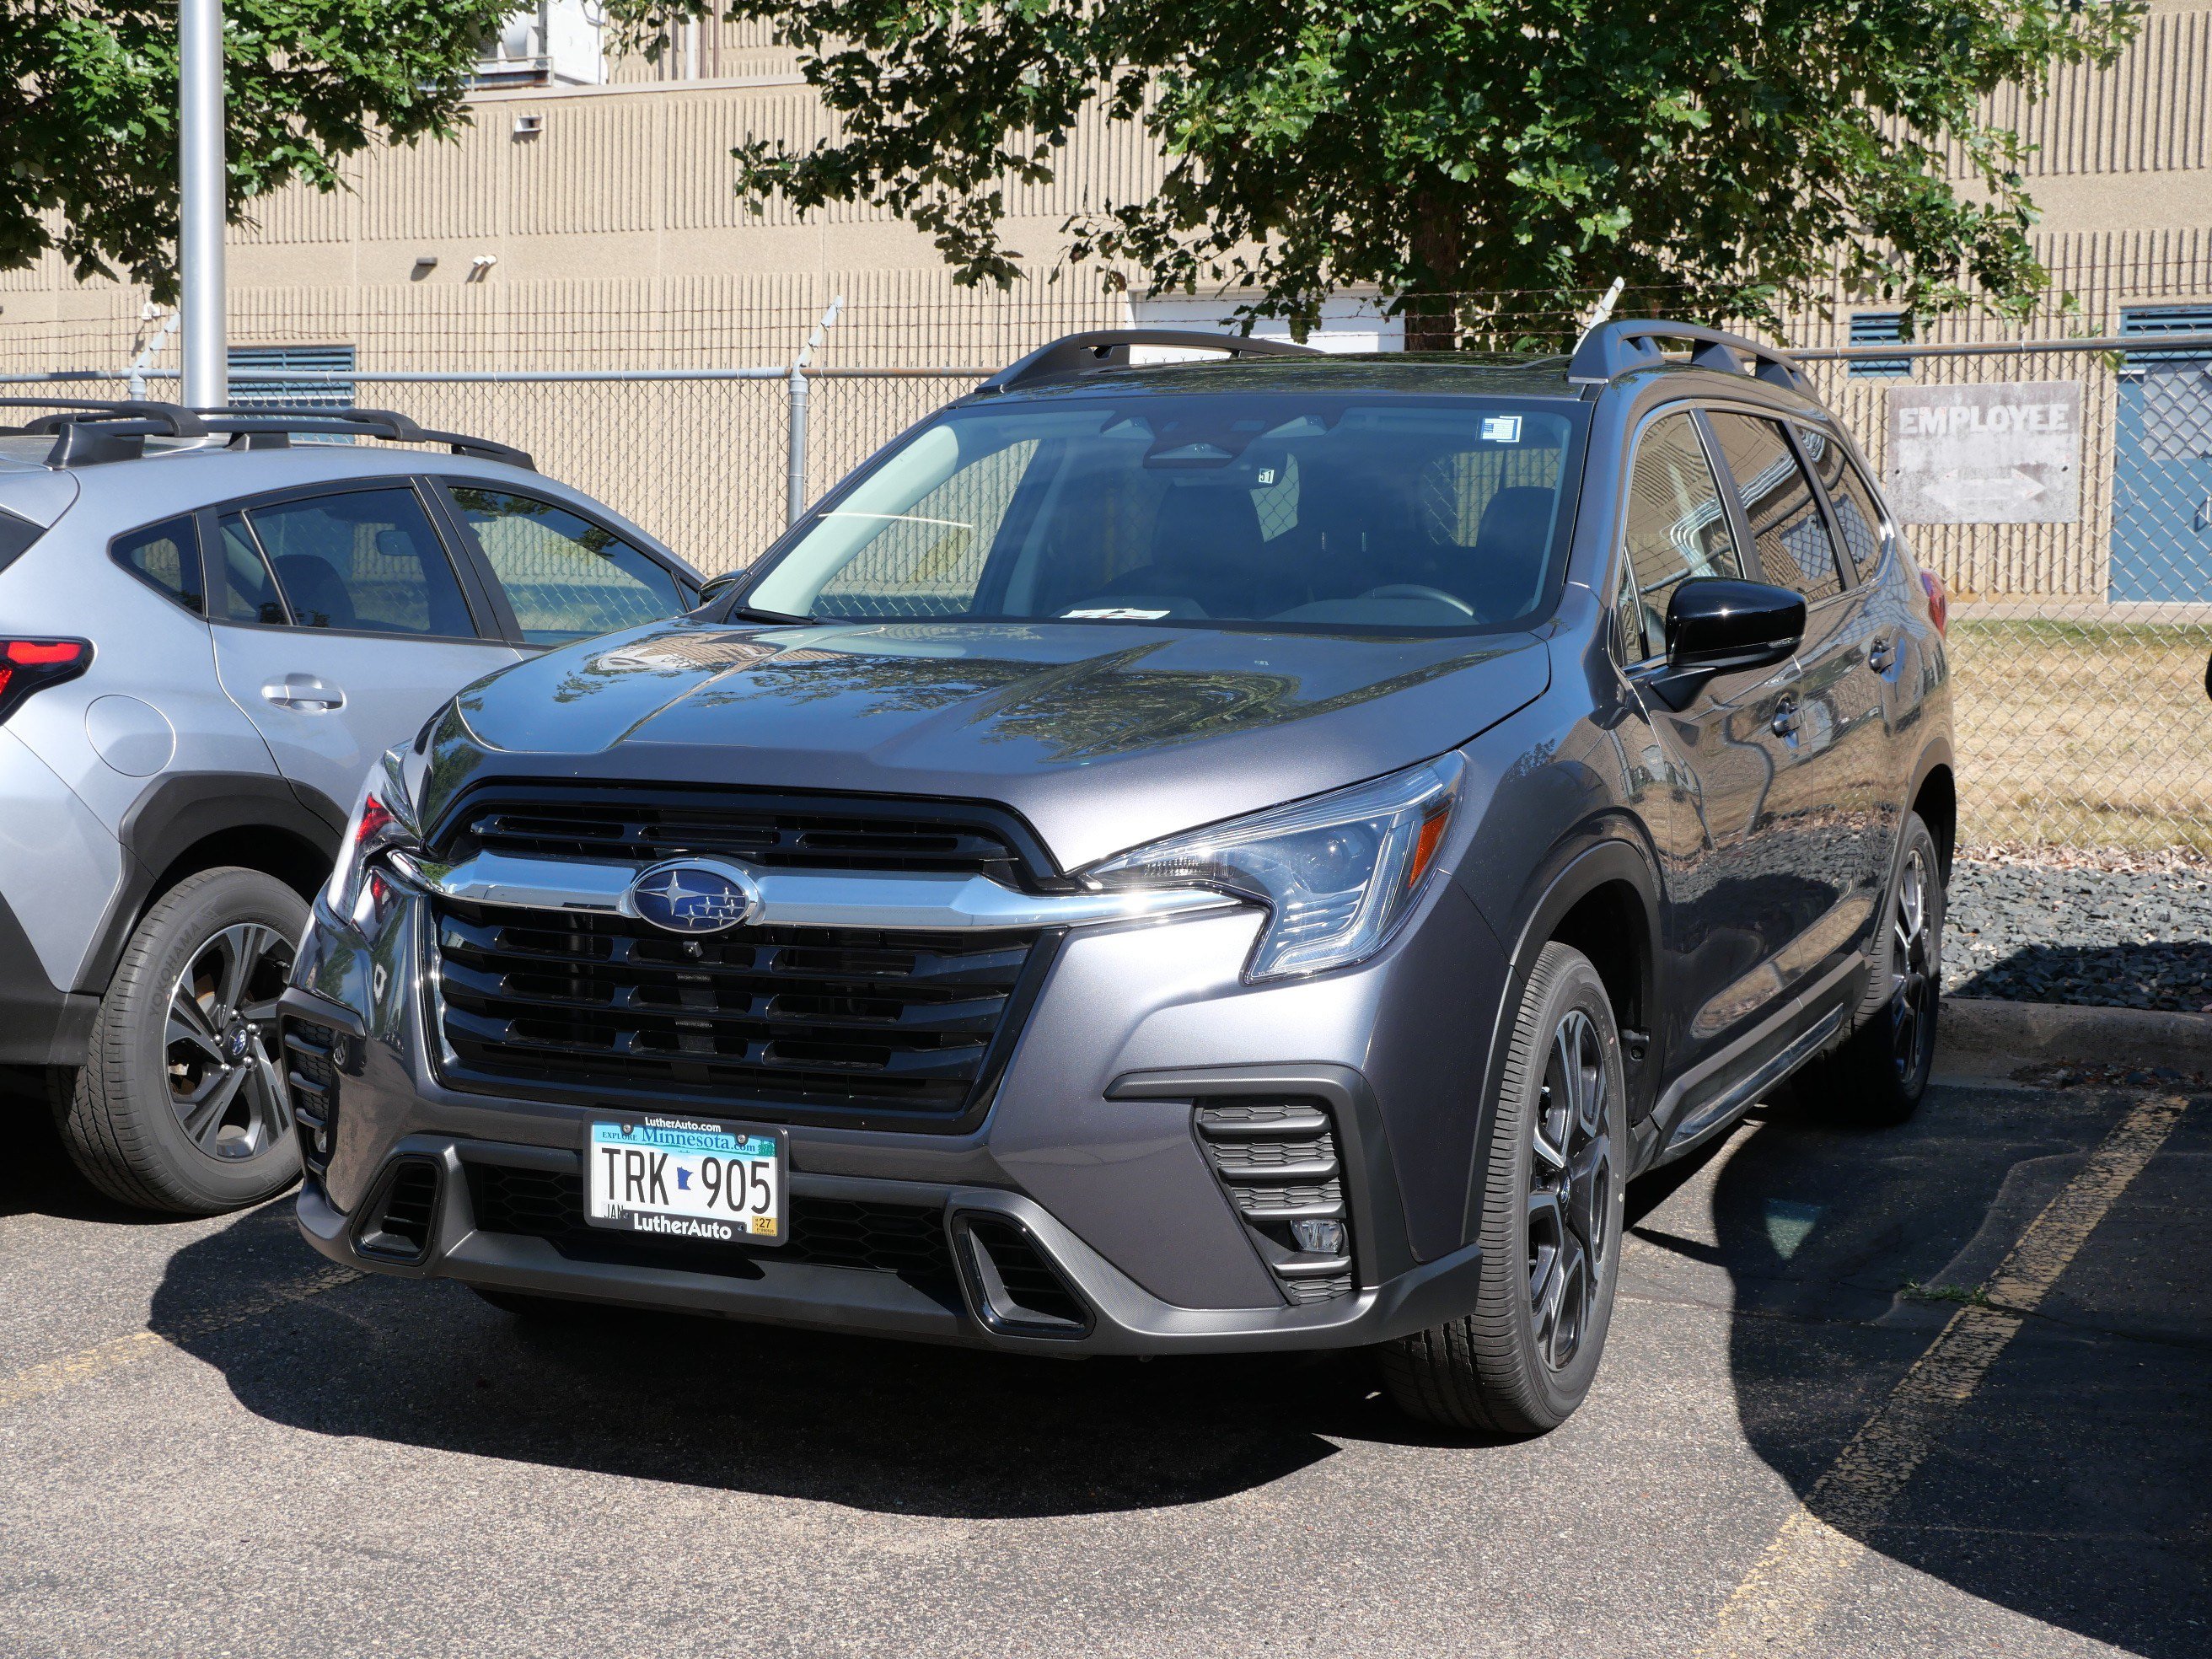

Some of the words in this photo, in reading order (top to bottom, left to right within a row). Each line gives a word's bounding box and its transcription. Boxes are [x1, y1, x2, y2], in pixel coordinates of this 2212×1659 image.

[1898, 403, 2070, 433] EMPLOYEE
[1260, 470, 1272, 482] 51
[149, 921, 201, 1016] YOKOHAMA
[644, 1117, 722, 1133] LutherAuto.com
[602, 1131, 638, 1141] EXPLORE
[601, 1147, 669, 1205] TRK
[701, 1157, 771, 1215] 905
[604, 1204, 623, 1219] JAN
[634, 1212, 732, 1240] LutherAuto
[759, 1217, 771, 1229] 27
